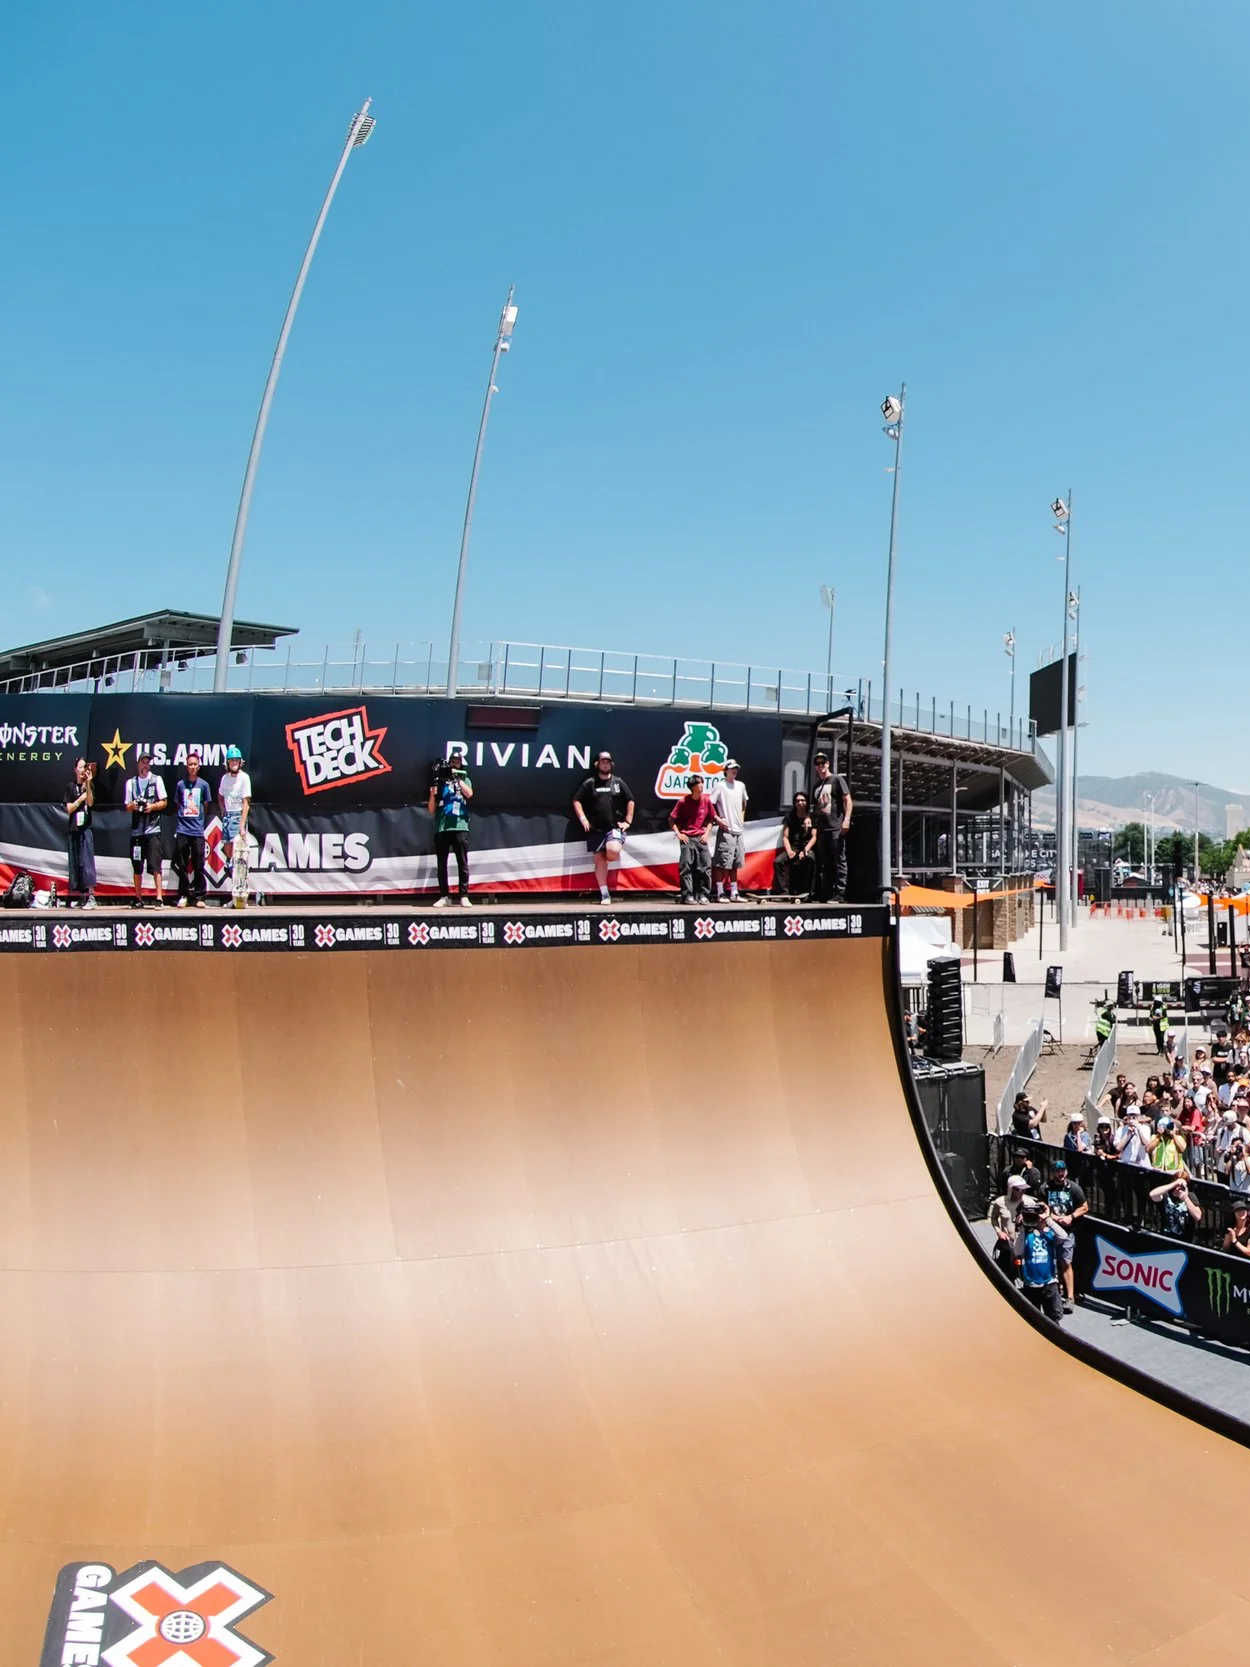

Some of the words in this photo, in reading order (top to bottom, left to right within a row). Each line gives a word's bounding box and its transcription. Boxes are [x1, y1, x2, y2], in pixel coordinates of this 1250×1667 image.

[0, 722, 79, 749] ONSTER
[294, 714, 364, 761] TECH
[446, 741, 591, 769] RIVIAN
[664, 775, 727, 790] JARTOS
[335, 927, 382, 941] GAMES
[387, 923, 399, 938] 30
[429, 925, 477, 940] GAMES
[482, 922, 494, 937] 30
[524, 924, 573, 939] GAMES
[577, 920, 590, 935] 30
[620, 922, 668, 937] GAMES
[672, 918, 685, 933] 30
[715, 919, 760, 934] GAMES
[764, 916, 776, 930] 30
[803, 917, 847, 932] GAMES
[850, 914, 862, 929] 30
[35, 926, 46, 941] 30
[71, 927, 113, 942] GAMES
[116, 924, 127, 939] 30
[154, 926, 198, 941] GAMES
[202, 924, 214, 940] 30
[242, 928, 288, 942] GAMES
[292, 924, 304, 939] 30
[1101, 1254, 1174, 1292] SONIC
[60, 1564, 113, 1667] GAME
